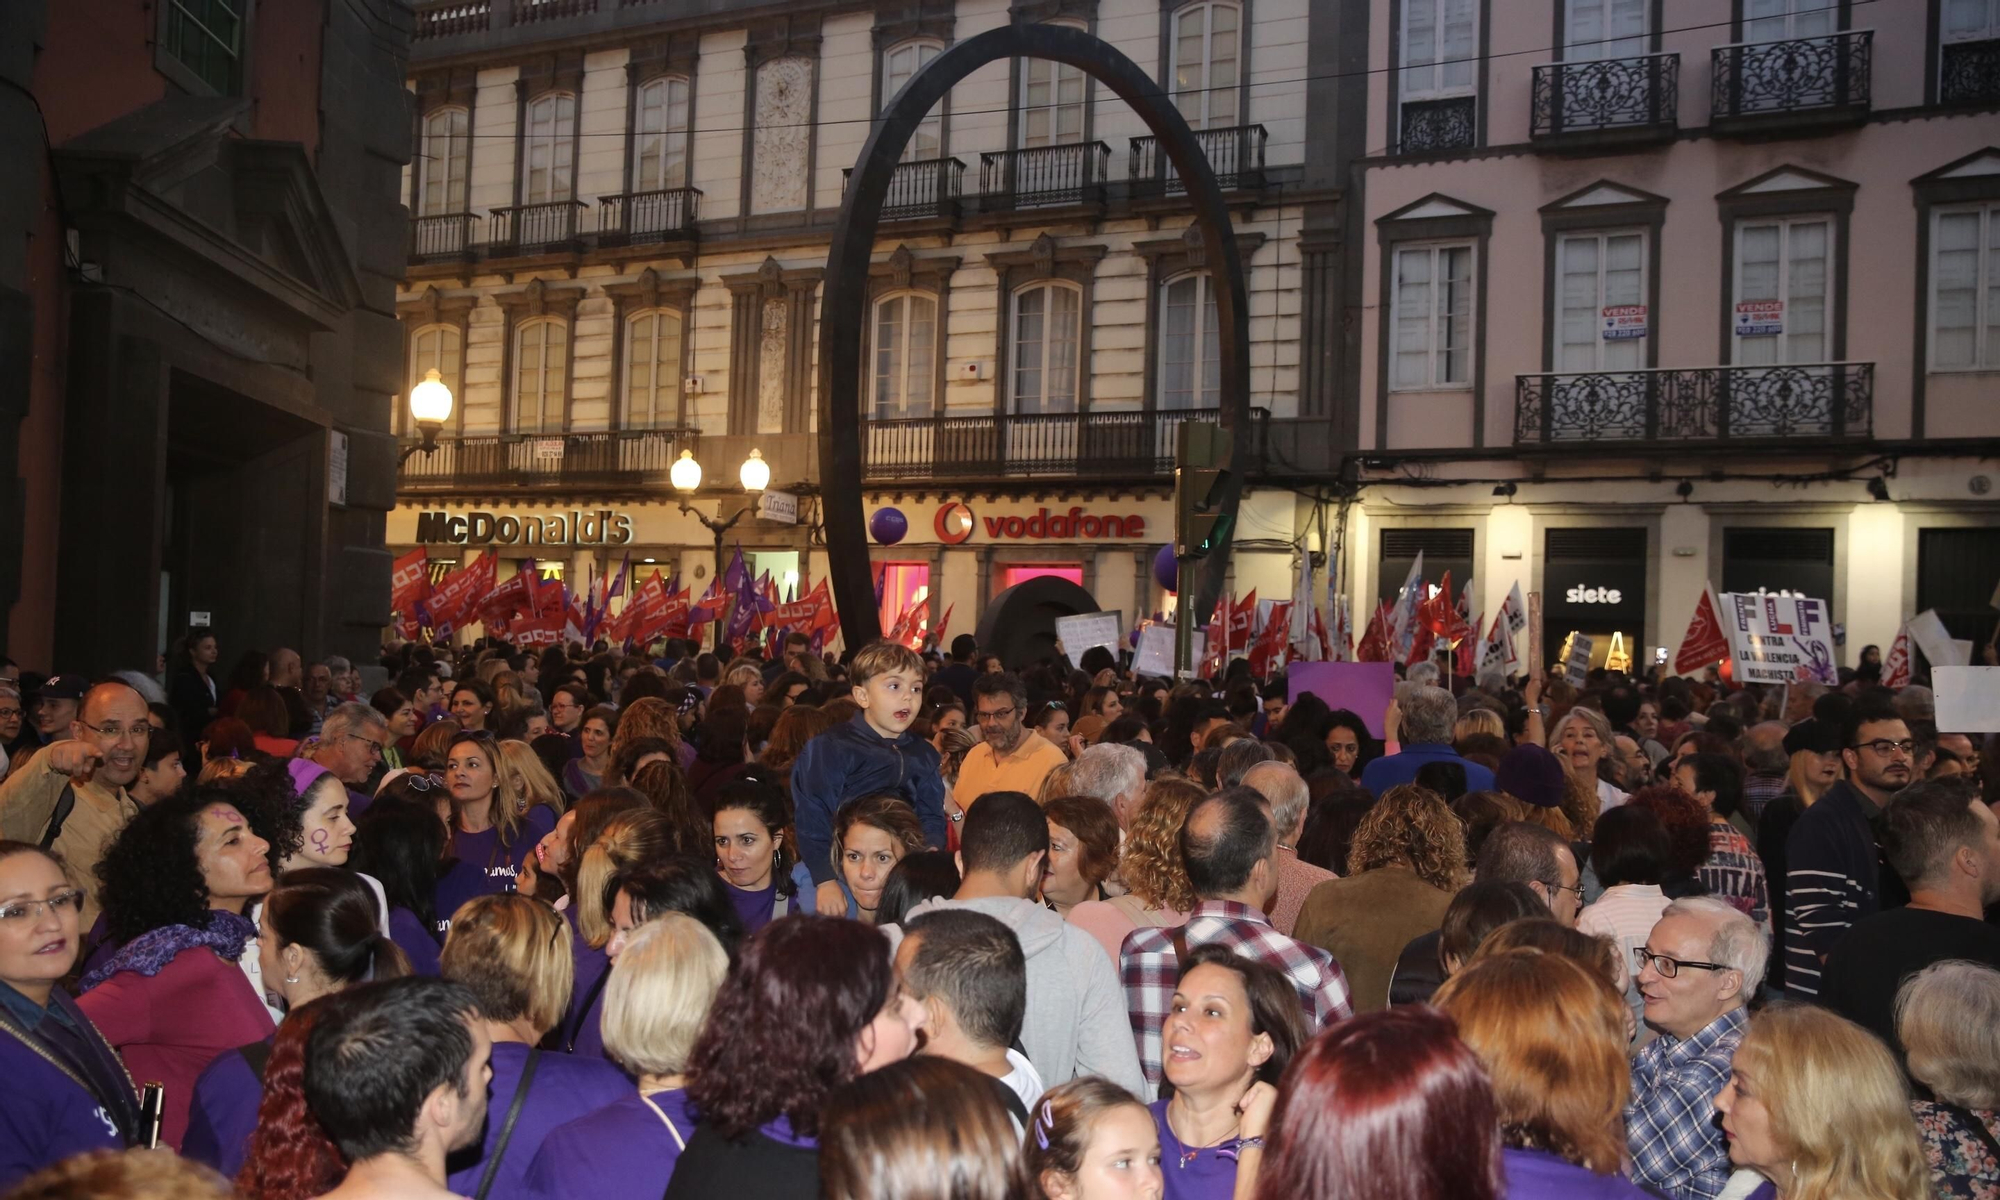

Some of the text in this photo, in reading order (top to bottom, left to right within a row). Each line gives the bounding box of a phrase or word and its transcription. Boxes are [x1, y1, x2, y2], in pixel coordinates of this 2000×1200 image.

[1603, 306, 1646, 316] VENDE
[1737, 302, 1782, 312] VENDE
[416, 510, 631, 544] McDonald's
[983, 506, 1145, 539] vodafone
[1566, 583, 1622, 604] siete
[1766, 601, 1778, 631] LUCHA
[1739, 650, 1751, 661] LA
[1748, 668, 1796, 681] MACHISTA
